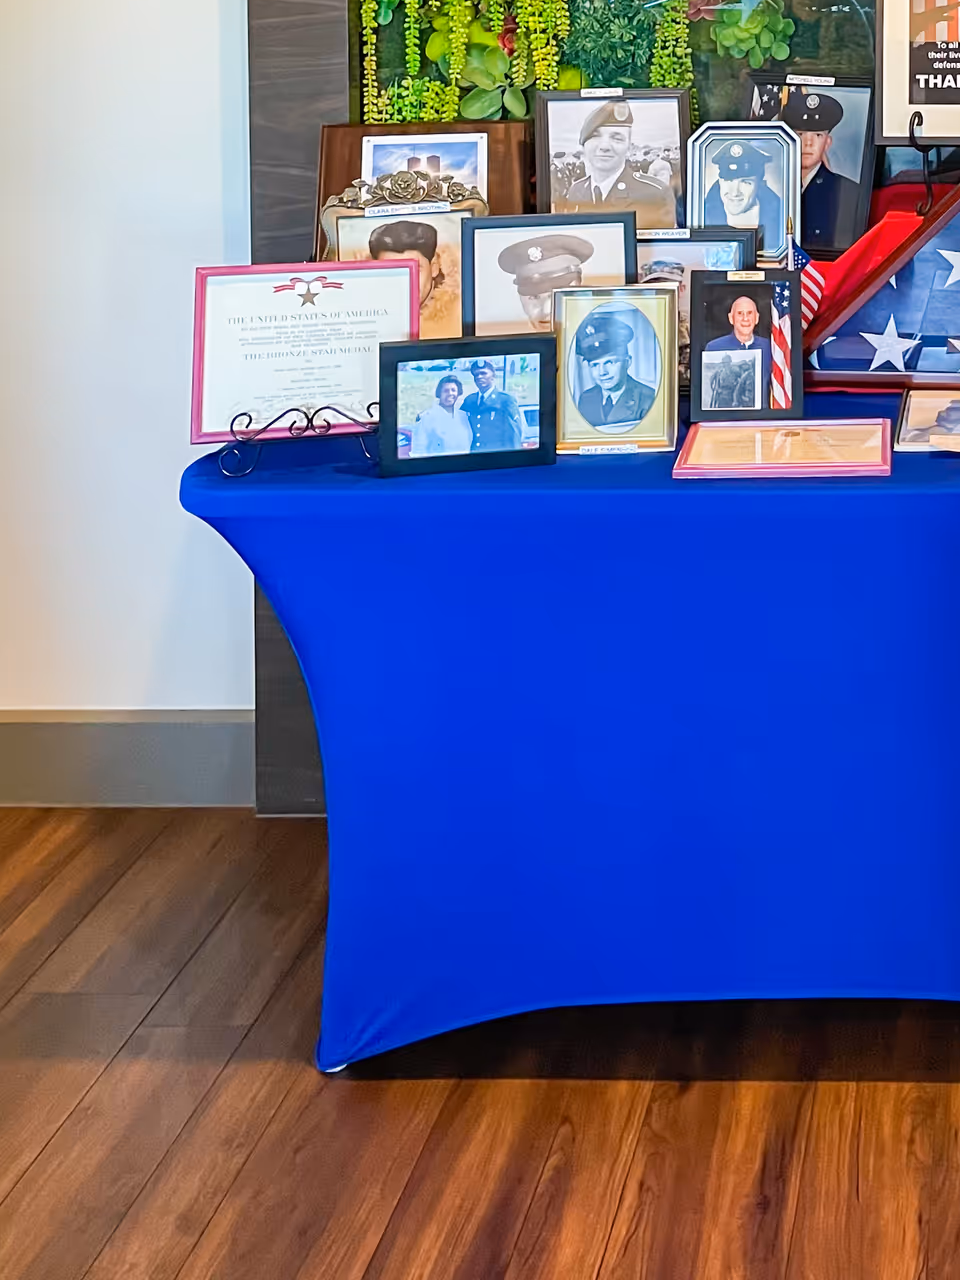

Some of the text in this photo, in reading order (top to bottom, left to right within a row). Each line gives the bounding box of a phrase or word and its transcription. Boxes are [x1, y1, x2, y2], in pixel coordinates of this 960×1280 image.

[948, 41, 958, 49] all
[928, 51, 948, 59] their
[368, 208, 390, 216] CLARA
[228, 308, 389, 325] THE UNITED STATES OF AMERICA
[243, 346, 374, 361] THE BRONZE STAR MEDAL
